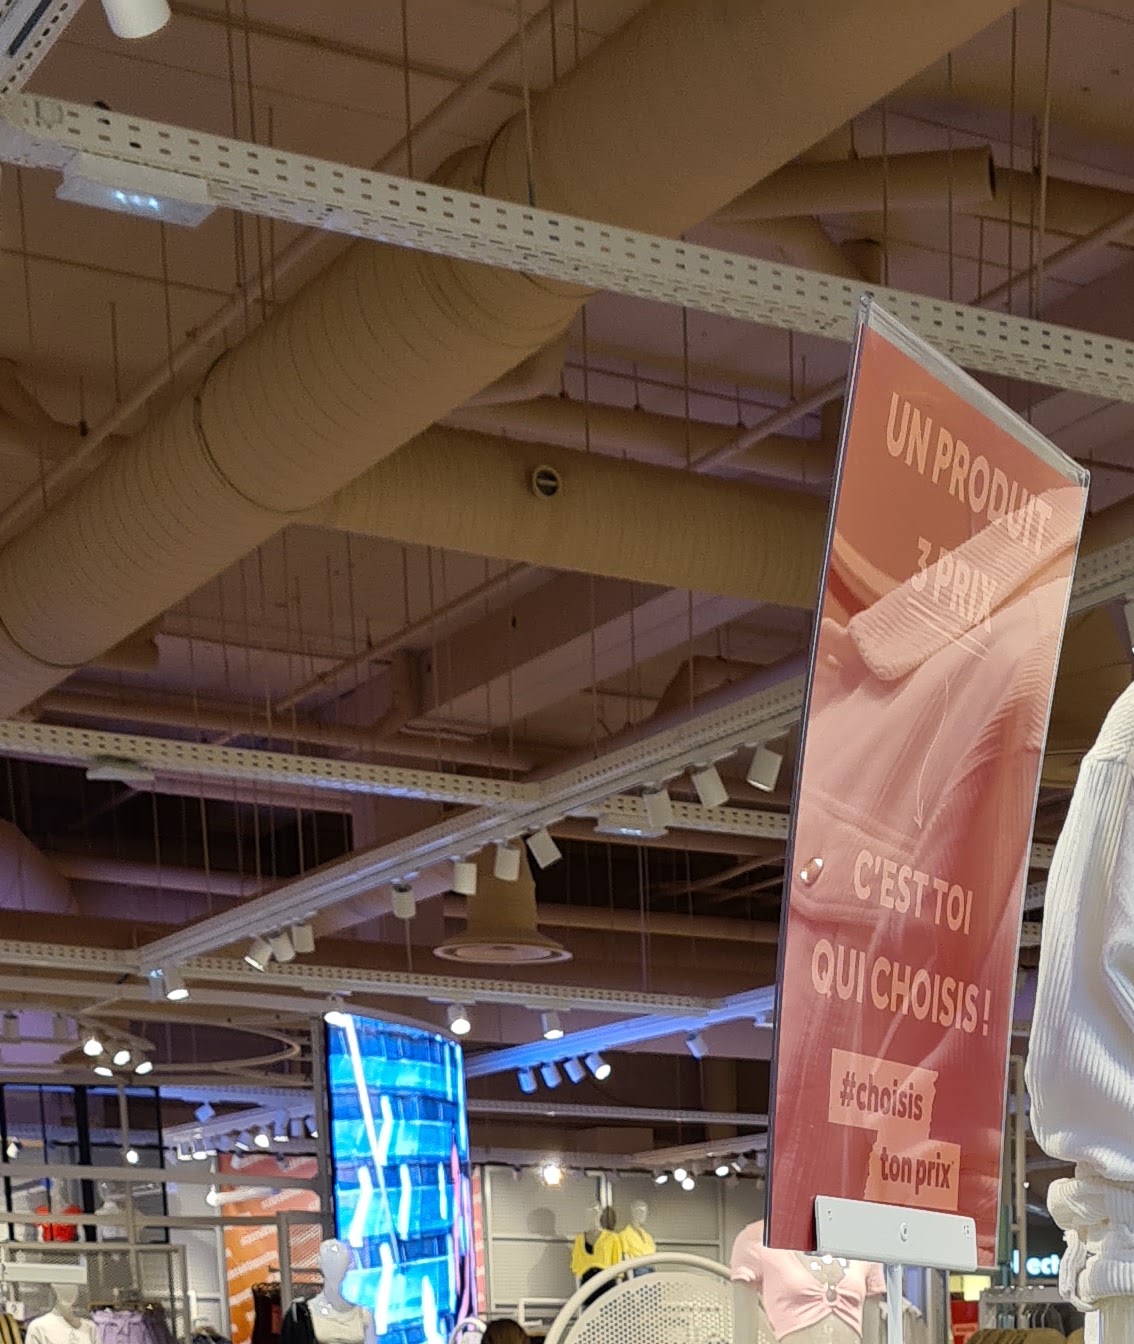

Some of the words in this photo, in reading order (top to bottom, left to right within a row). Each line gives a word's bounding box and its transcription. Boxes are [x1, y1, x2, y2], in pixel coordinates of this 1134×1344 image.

[886, 391, 933, 476] UN
[931, 429, 1053, 553] PRODUIT
[912, 536, 935, 592] 3
[934, 549, 999, 634] PRIX
[853, 849, 929, 919] C'EST
[932, 878, 974, 935] TOI
[811, 938, 867, 1003] QUI
[871, 956, 980, 1034] CHOISIS
[839, 1070, 924, 1122] #choisis
[880, 1146, 912, 1185] ton
[915, 1151, 952, 1196] prix
